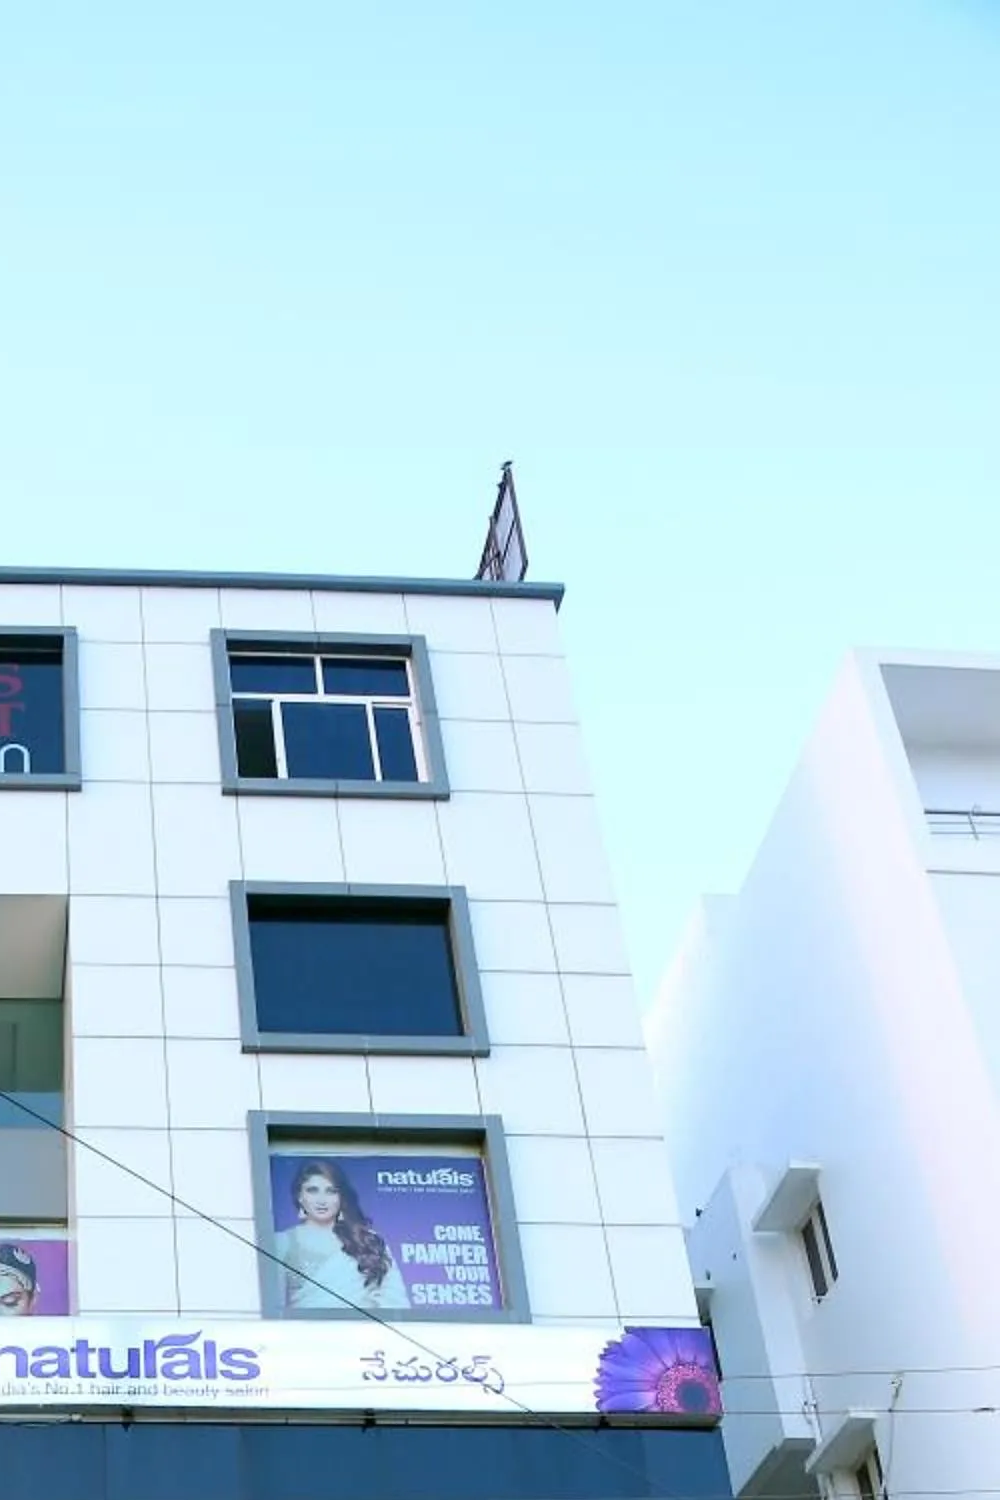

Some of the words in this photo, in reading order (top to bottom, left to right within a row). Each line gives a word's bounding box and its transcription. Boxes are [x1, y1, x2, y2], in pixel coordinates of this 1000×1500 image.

[401, 1243, 489, 1265] PAMPER
[444, 1265, 491, 1283] YOUR
[411, 1284, 493, 1306] SENSES
[127, 1384, 159, 1396] and
